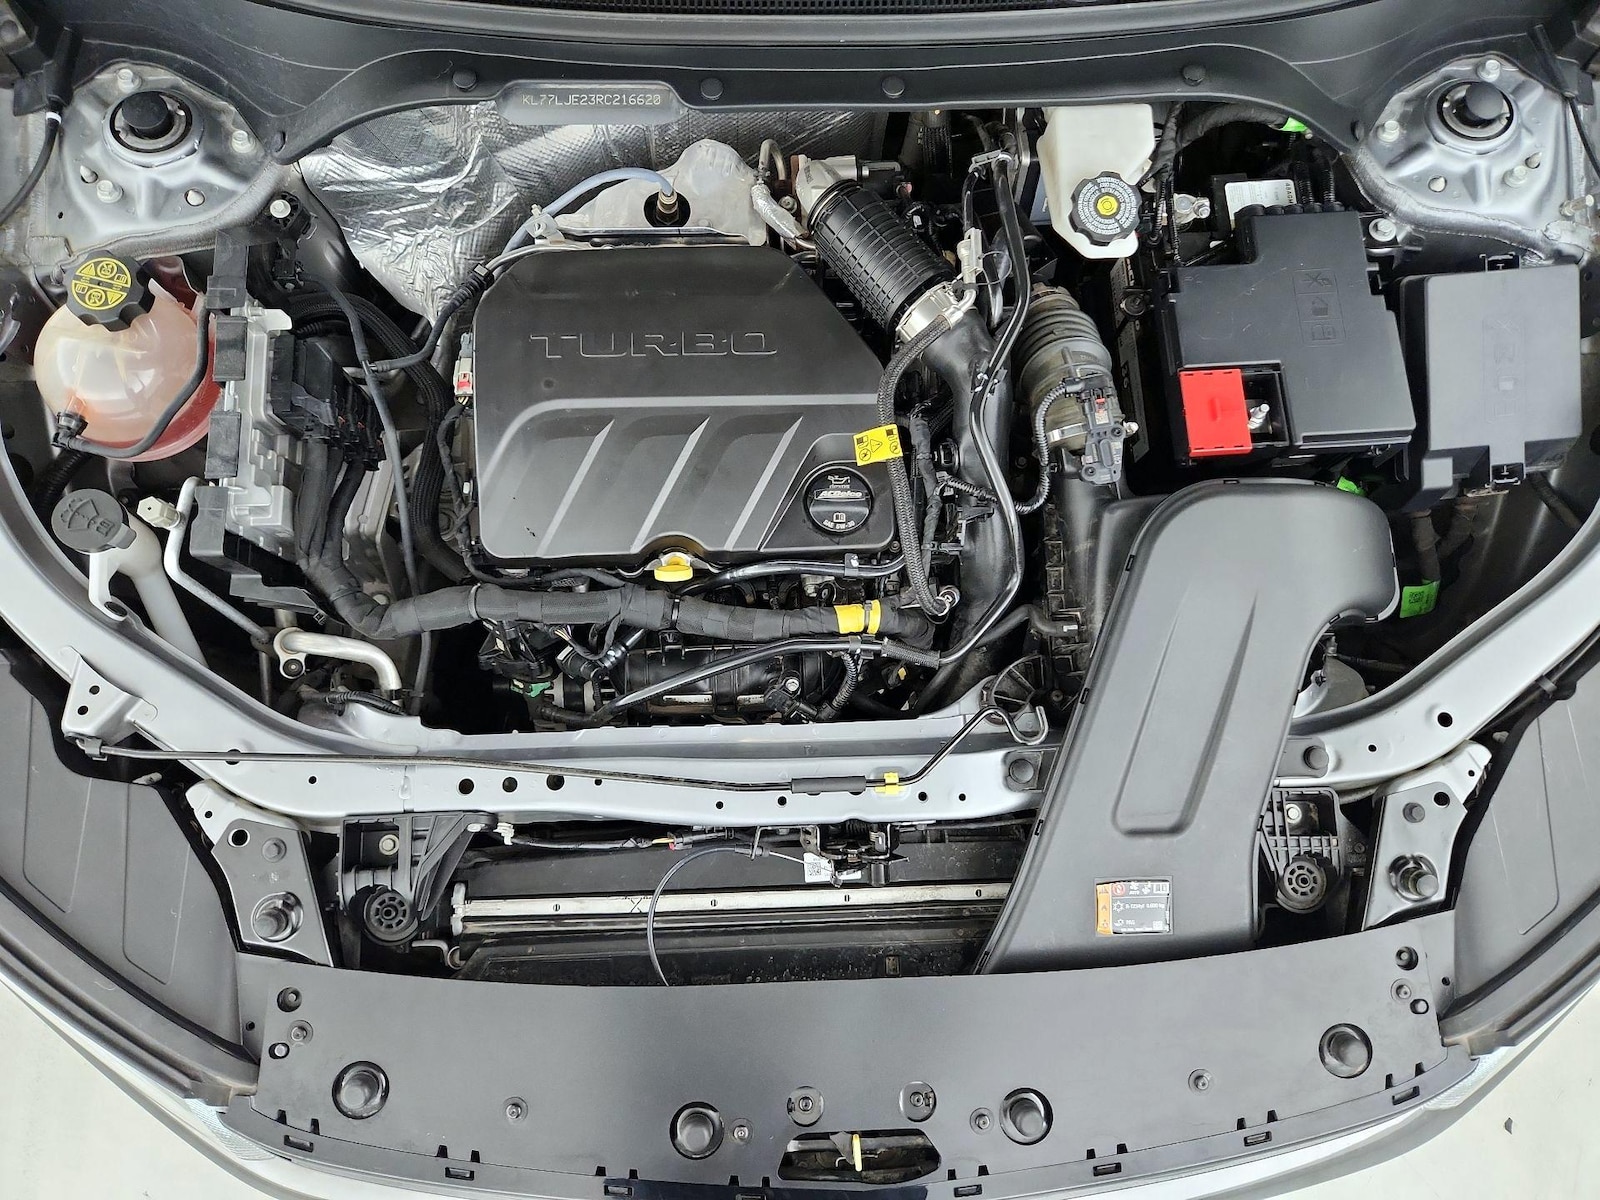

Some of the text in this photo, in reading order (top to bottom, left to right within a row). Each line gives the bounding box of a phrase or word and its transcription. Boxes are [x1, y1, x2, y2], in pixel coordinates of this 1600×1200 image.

[522, 94, 661, 106] KL77LJE23RC216620
[529, 331, 777, 359] TURBO
[819, 490, 862, 498] ACDelco
